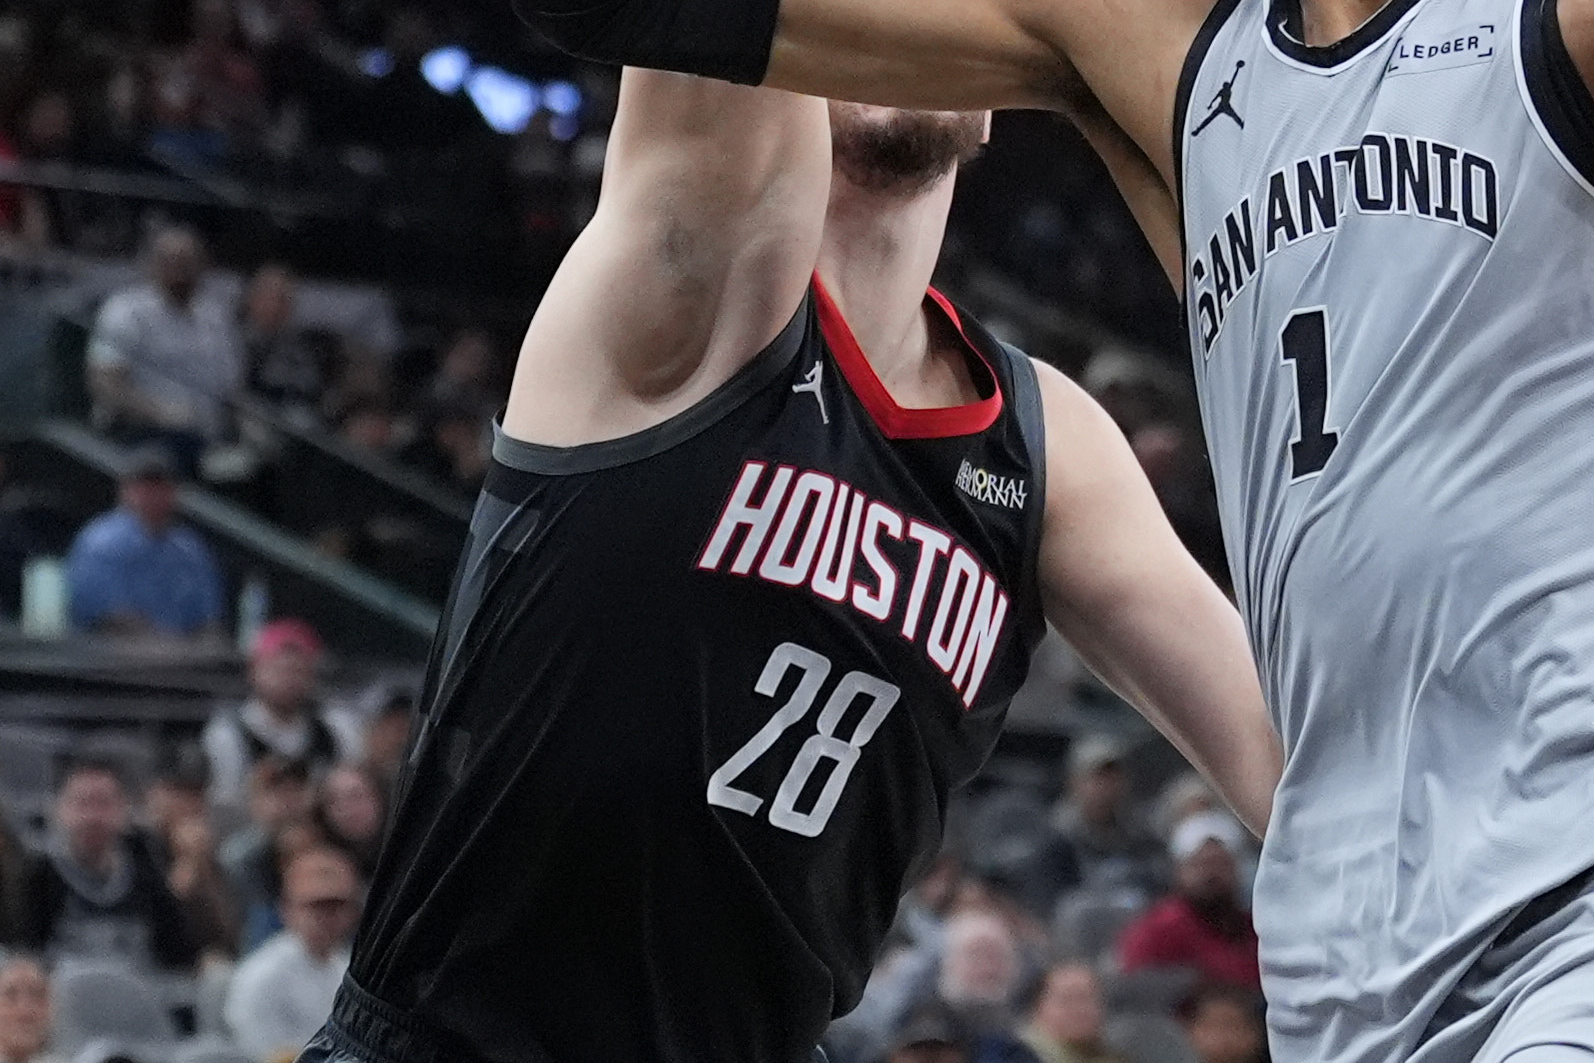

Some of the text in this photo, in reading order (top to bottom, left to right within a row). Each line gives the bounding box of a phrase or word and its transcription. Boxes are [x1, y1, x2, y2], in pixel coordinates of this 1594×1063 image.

[1399, 35, 1480, 60] LEDGER
[1193, 129, 1500, 362] SAN ANTONIO
[1277, 304, 1342, 487] 1
[697, 459, 1010, 712] HOUSTON
[706, 641, 902, 838] 28
